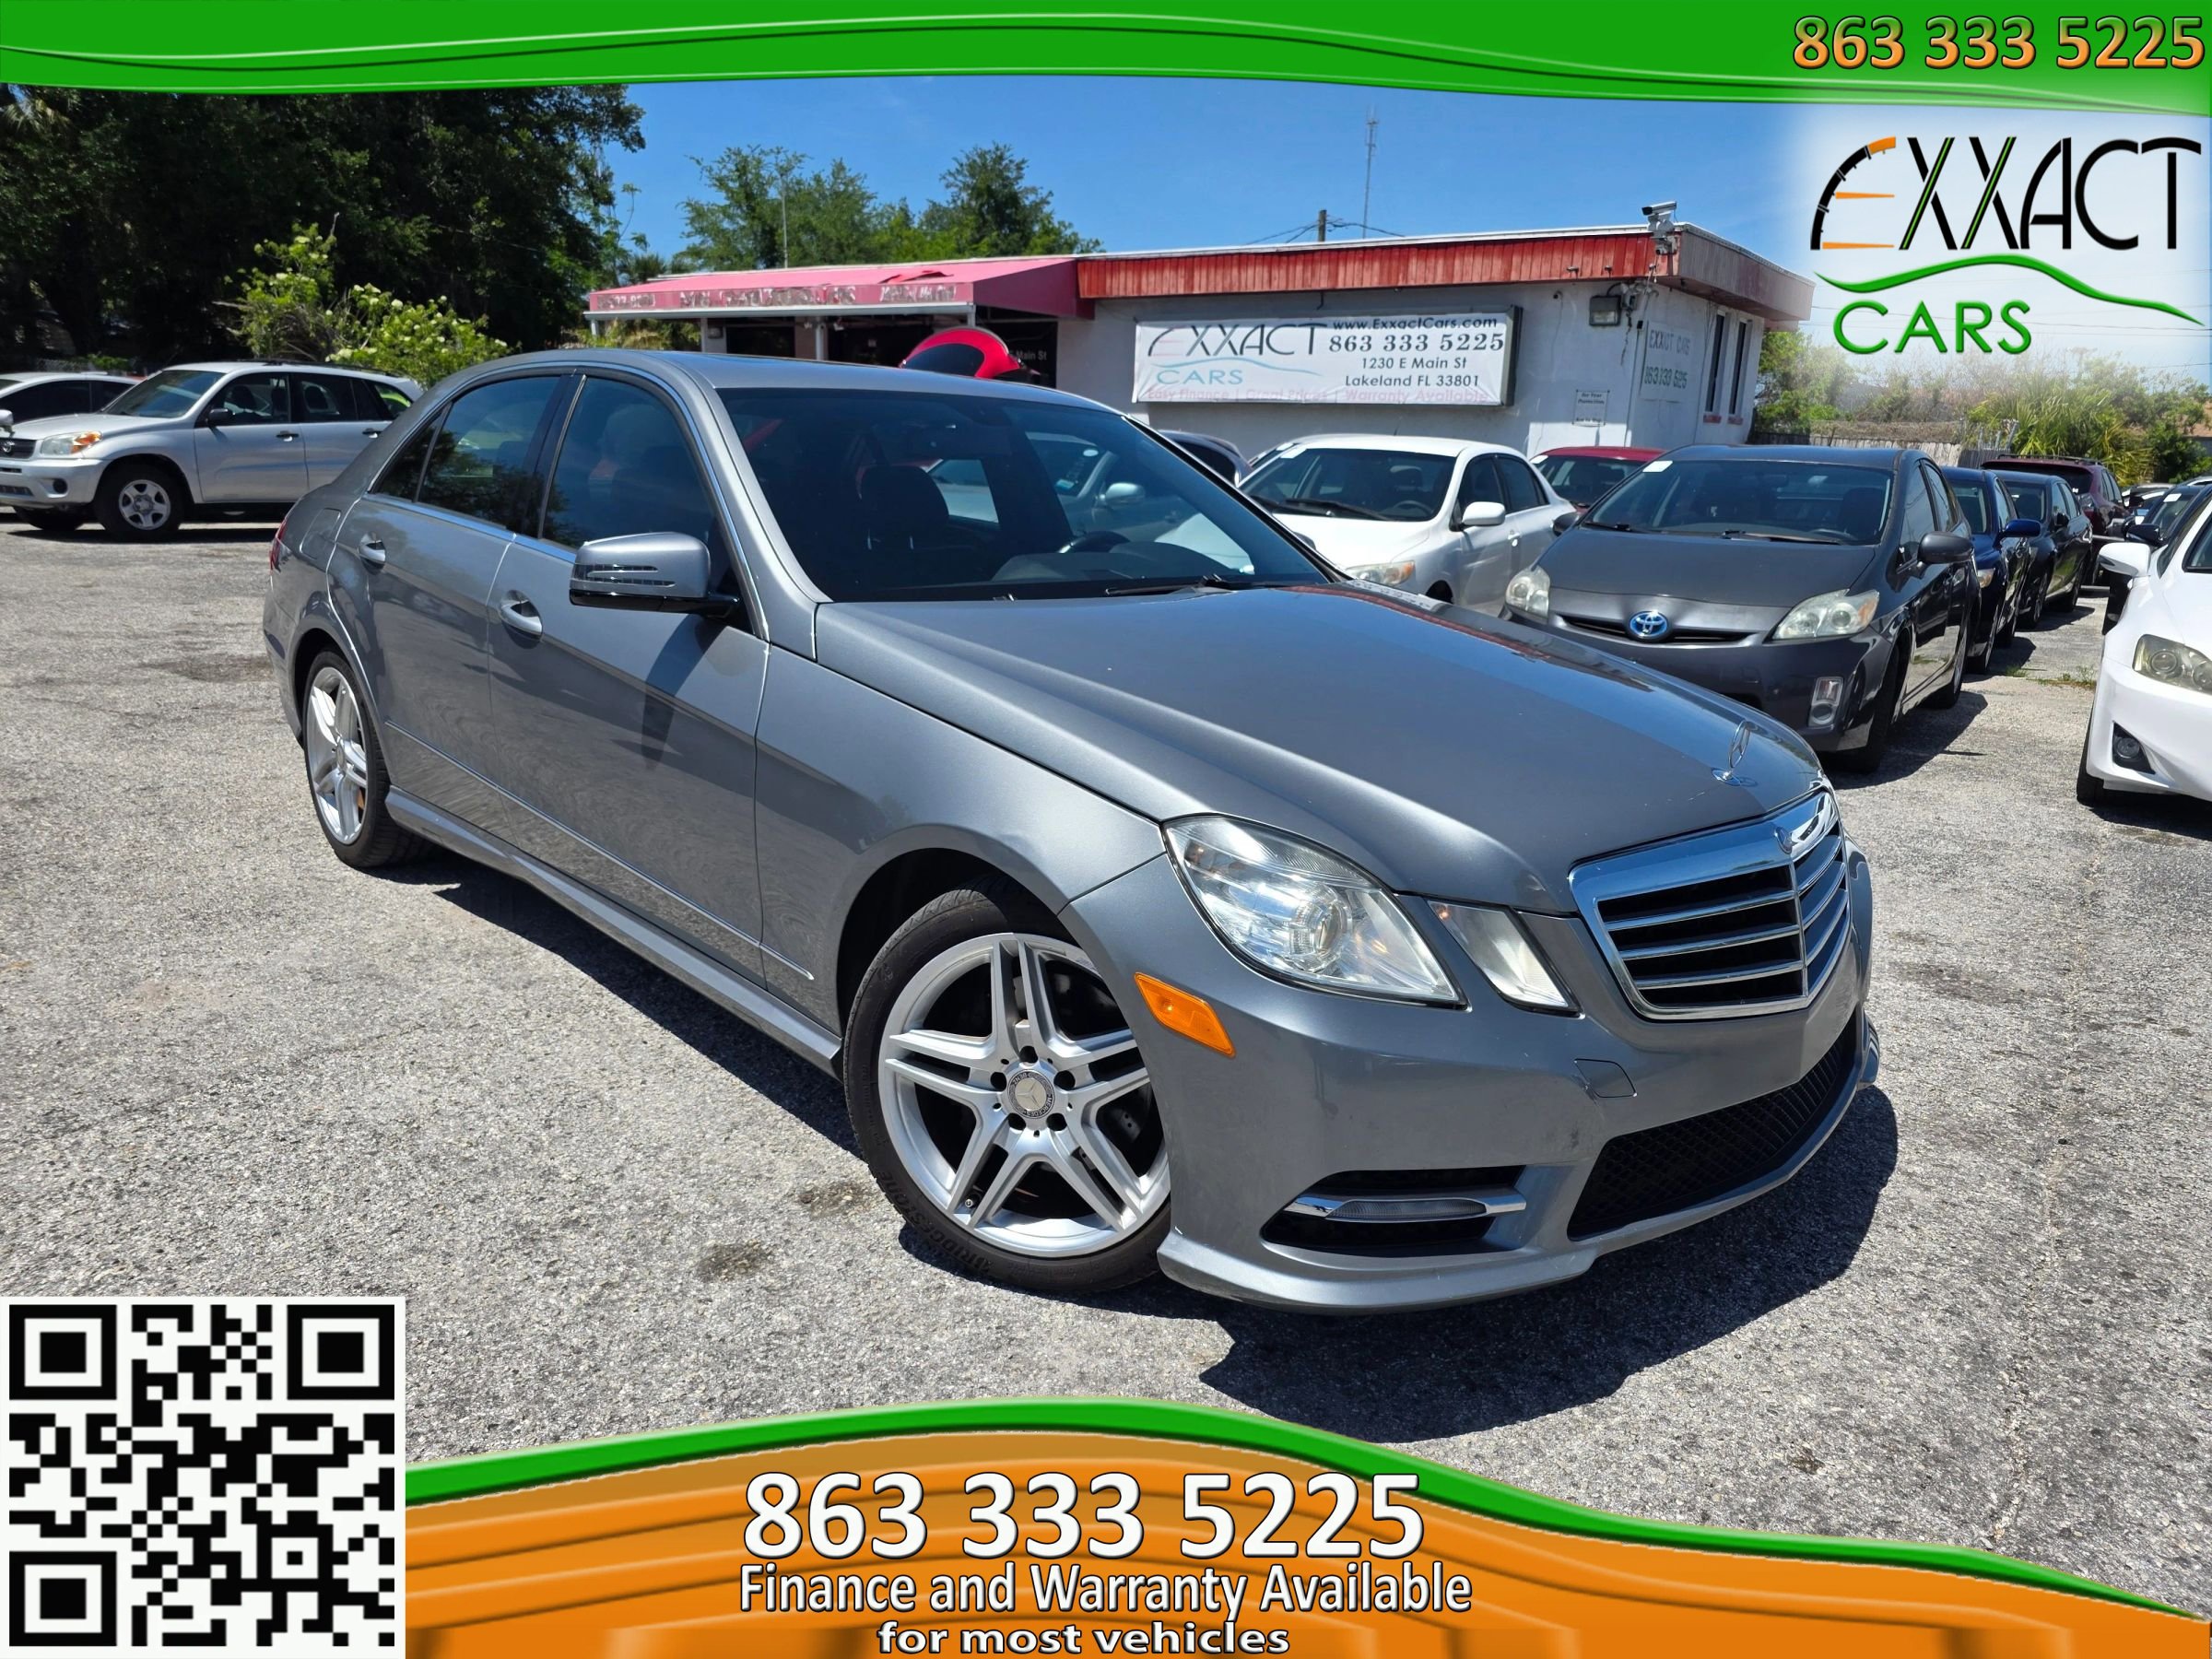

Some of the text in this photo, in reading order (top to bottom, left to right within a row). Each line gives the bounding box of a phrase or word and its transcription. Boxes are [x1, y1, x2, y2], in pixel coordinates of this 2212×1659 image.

[1148, 323, 1328, 357] EXXACT
[1329, 333, 1504, 352] 863 333 5225
[1362, 357, 1467, 369] 1230 E Main St
[1157, 370, 1243, 385] CARS
[1345, 374, 1478, 386] Lakeland FL 33801
